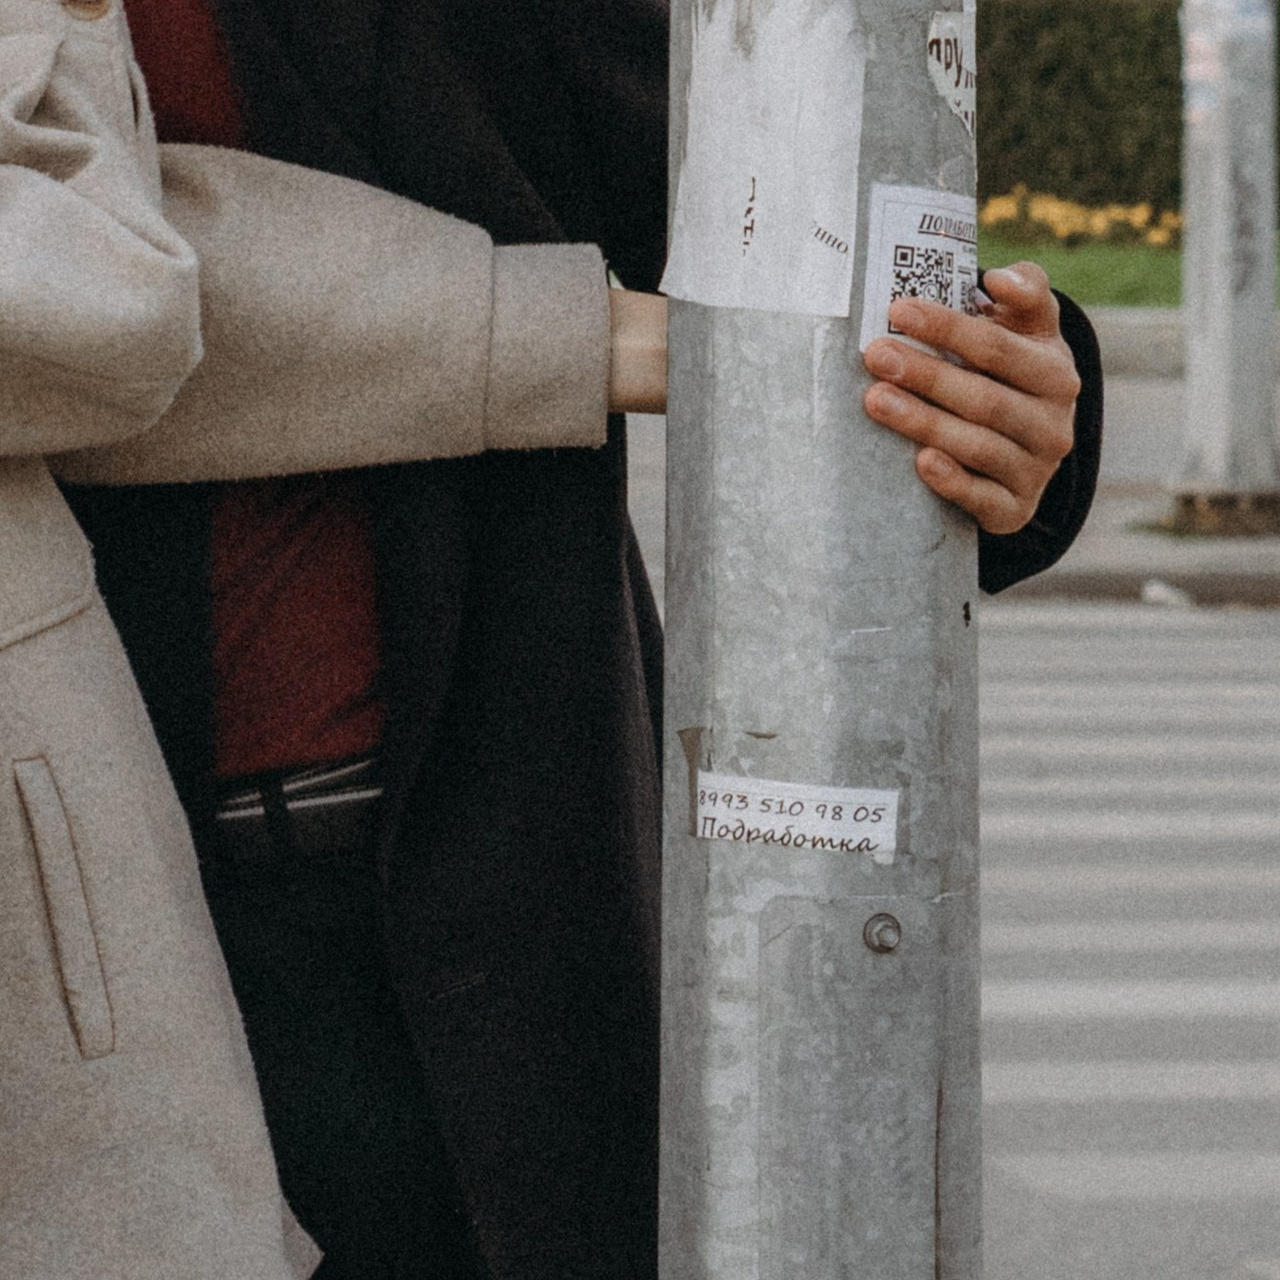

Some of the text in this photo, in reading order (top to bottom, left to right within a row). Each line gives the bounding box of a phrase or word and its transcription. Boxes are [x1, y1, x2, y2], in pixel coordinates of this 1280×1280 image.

[699, 790, 886, 823] 8993 510 98 05
[701, 816, 880, 853] Подработка
